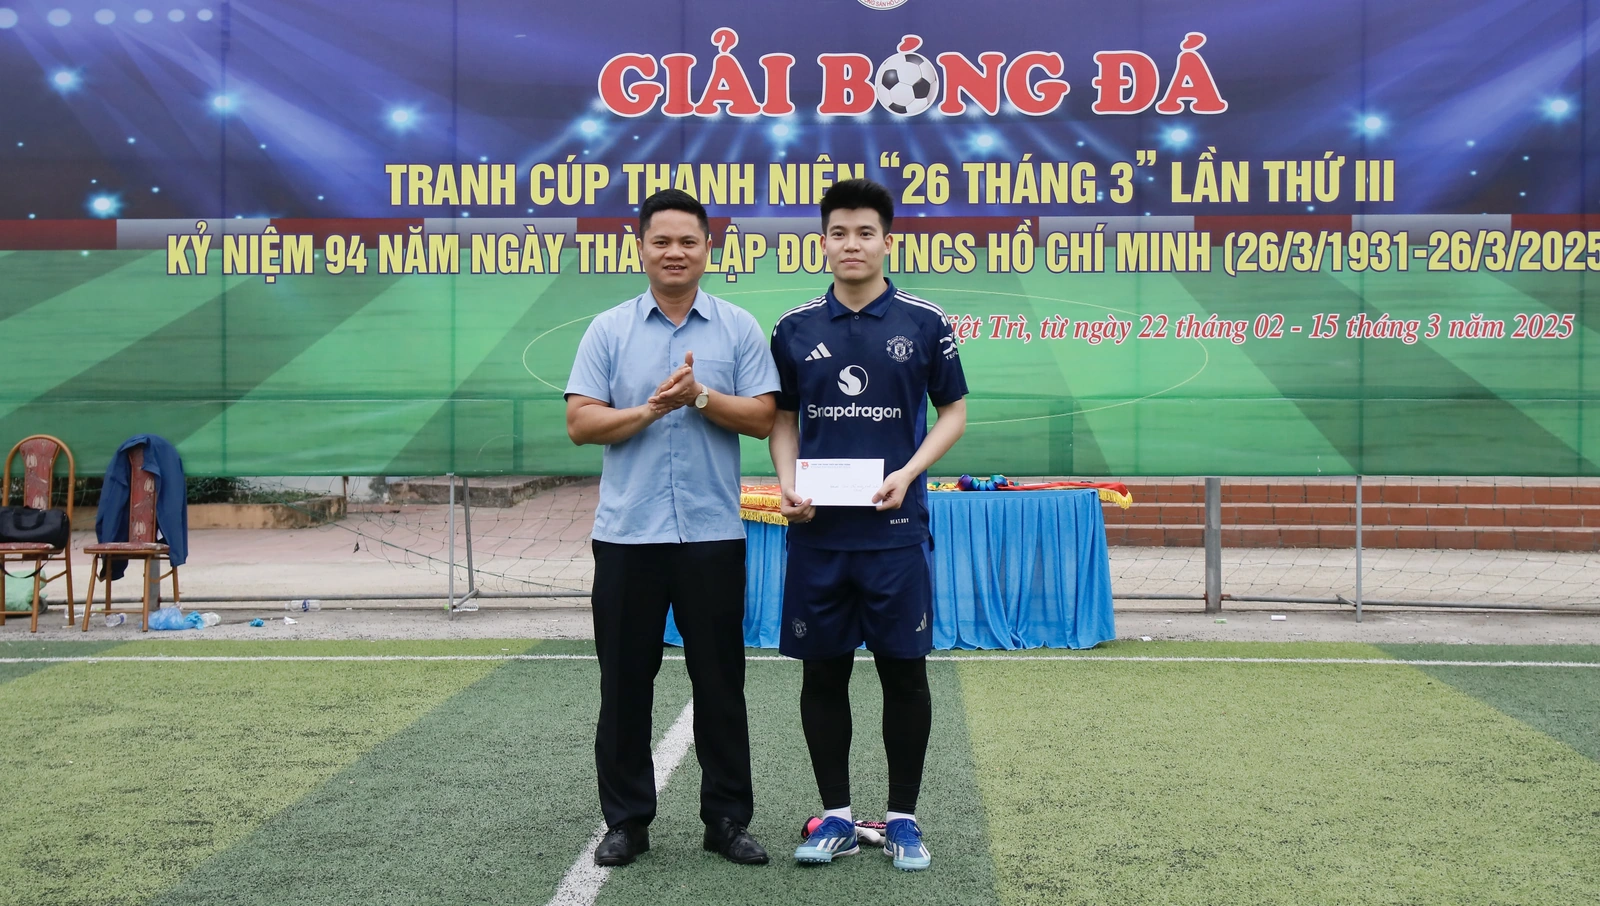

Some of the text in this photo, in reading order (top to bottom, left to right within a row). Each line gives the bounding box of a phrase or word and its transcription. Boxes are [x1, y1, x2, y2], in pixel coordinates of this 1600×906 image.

[598, 27, 1228, 117] GIẢI BÓNG ĐÁ
[385, 163, 516, 206] TRANH
[530, 154, 611, 206] CÚP
[622, 163, 755, 205] THANH
[963, 153, 1096, 205] THÁNG
[1171, 146, 1250, 203] LẦN
[1263, 151, 1346, 203] THỨ
[1355, 160, 1395, 203] III
[167, 220, 212, 275] KỶ
[222, 226, 314, 283] NIỆM
[325, 234, 368, 274] 94
[378, 225, 460, 274] NĂM
[471, 225, 566, 274] NGÀY
[575, 224, 645, 274] THÀ
[890, 232, 976, 274] TNCS
[987, 218, 1035, 274] HỒ
[1045, 222, 1105, 274] CHÍ
[1116, 231, 1211, 272] MINH
[947, 313, 1575, 345] iệt Trì, từ ngày 22 tháng 02 - 15 tháng 3 năm 2025
[807, 402, 902, 422] Snapdragon
